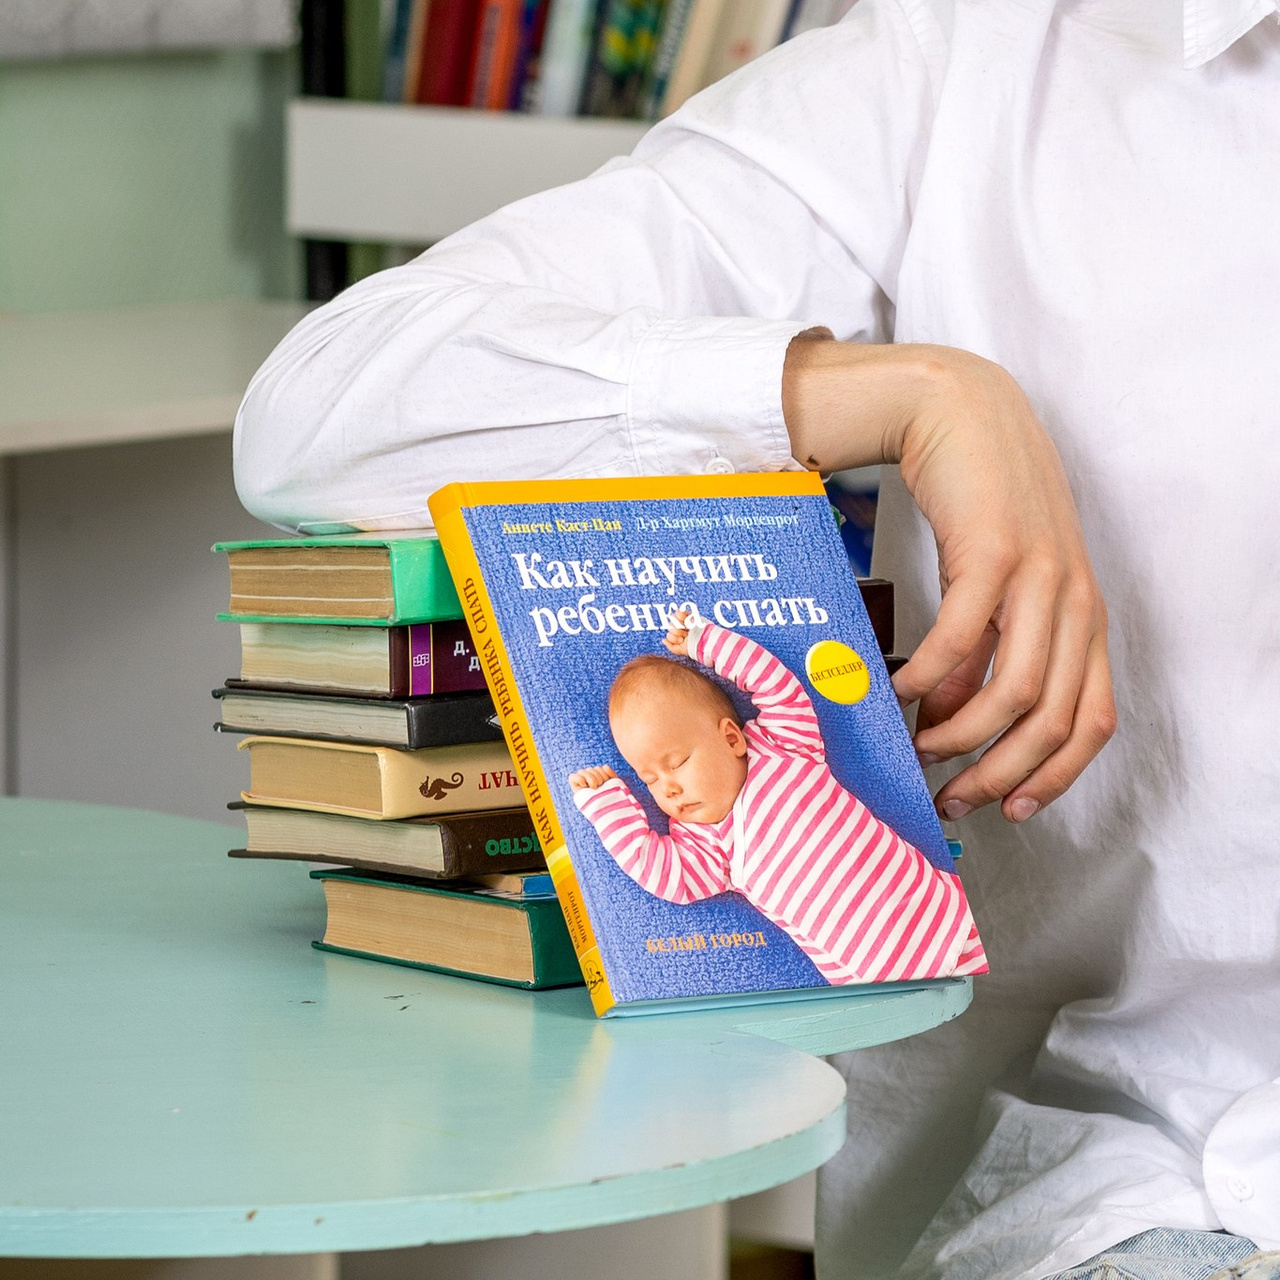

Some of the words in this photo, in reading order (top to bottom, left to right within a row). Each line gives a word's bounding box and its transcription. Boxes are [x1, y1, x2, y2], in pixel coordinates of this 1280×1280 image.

[660, 516, 720, 531] Хартмут
[723, 514, 799, 528] Моргенрот
[511, 552, 596, 590] Как
[603, 551, 779, 596] научить
[463, 577, 488, 634] СПАТЬ
[528, 593, 706, 647] ребенка
[713, 596, 829, 628] спать
[484, 637, 513, 718] РЕБЕНКА
[810, 661, 863, 682] БЕСТСЕЛЛЕР
[509, 721, 541, 804] НАУЧИТЬ
[536, 808, 555, 846] КАК
[646, 933, 707, 953] БЕЛЫЙ
[710, 931, 767, 949] ГОРОД
